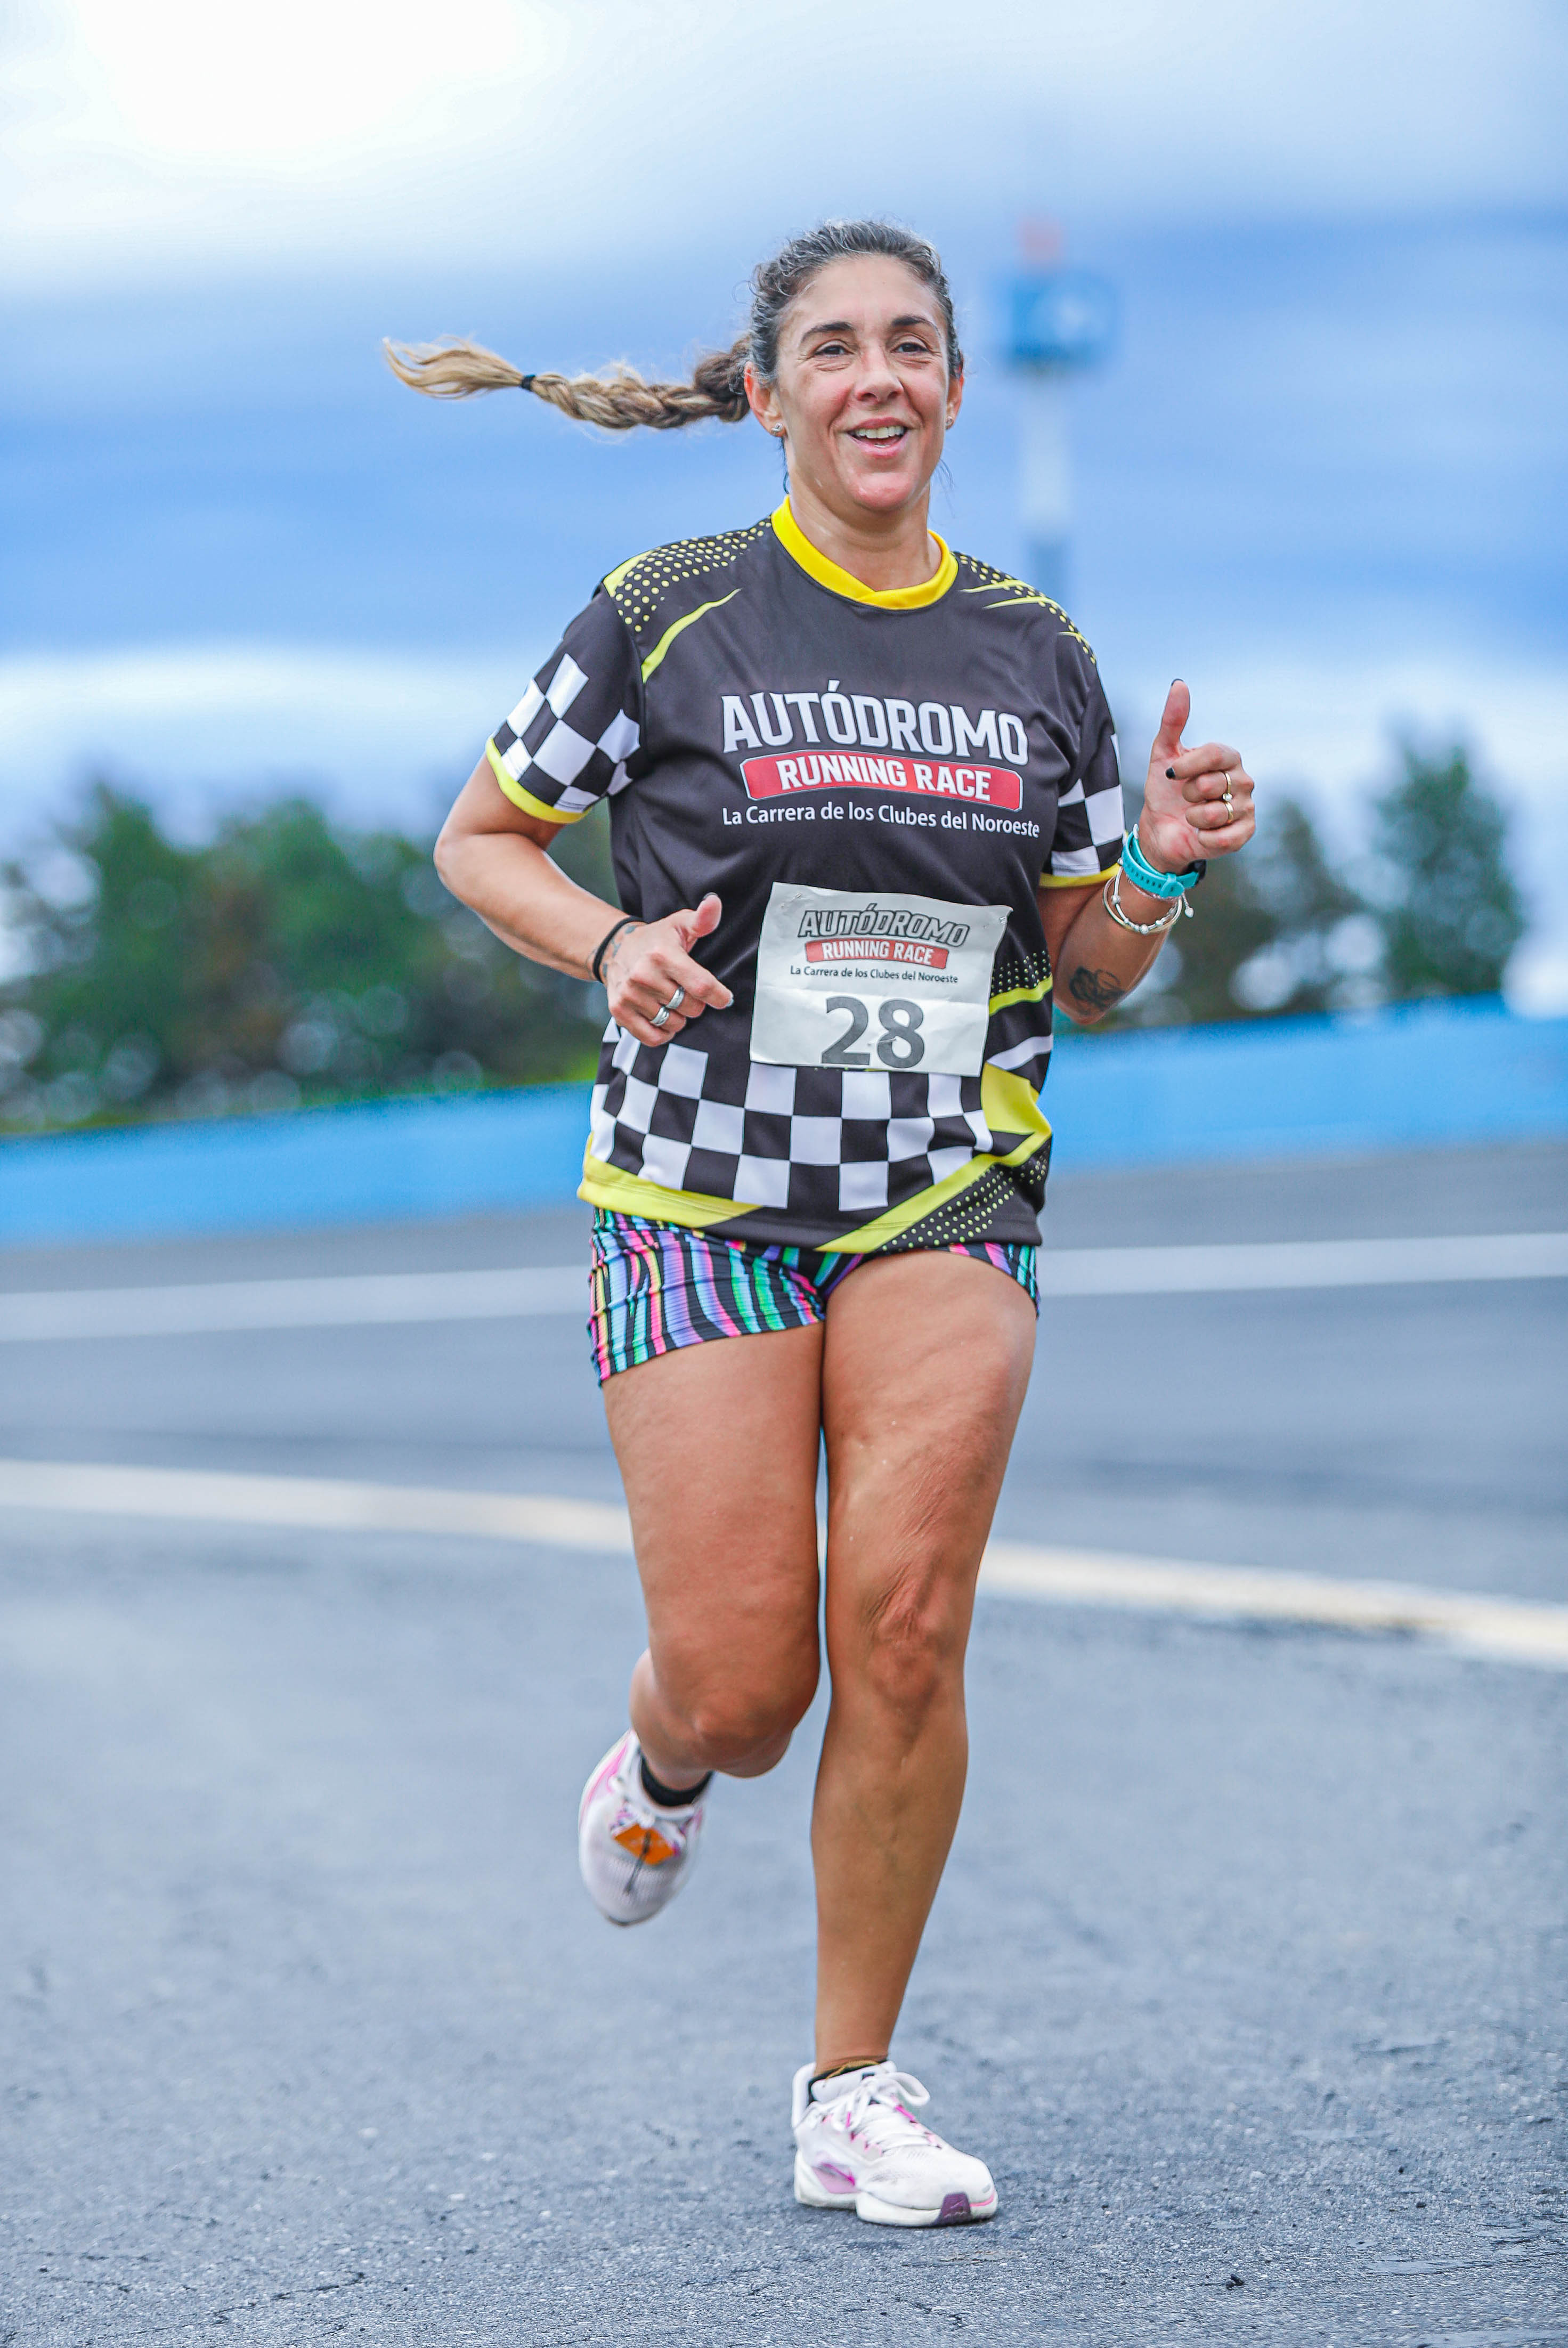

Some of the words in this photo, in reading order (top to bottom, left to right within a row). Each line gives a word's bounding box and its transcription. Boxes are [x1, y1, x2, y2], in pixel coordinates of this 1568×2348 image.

[721, 680, 1028, 766] AUTÓDROMO
[776, 754, 907, 791] RUNNING
[913, 762, 992, 801] RACE
[722, 807, 742, 825] La
[746, 805, 815, 824] Carrera
[820, 802, 843, 820] de
[849, 801, 874, 822] los
[878, 805, 936, 827] Clubes
[941, 811, 967, 830] del
[972, 815, 1040, 838] Noroeste
[798, 903, 970, 947] AUTÓDROMO
[791, 965, 800, 974] La
[804, 966, 838, 977] Carrera
[840, 967, 852, 977] de
[855, 968, 867, 978] los
[871, 969, 900, 979] Clubes
[901, 970, 916, 980] del
[918, 972, 958, 983] Noroeste
[822, 941, 889, 958] RUNNING
[893, 941, 935, 964] RACE
[822, 996, 925, 1068] 28
